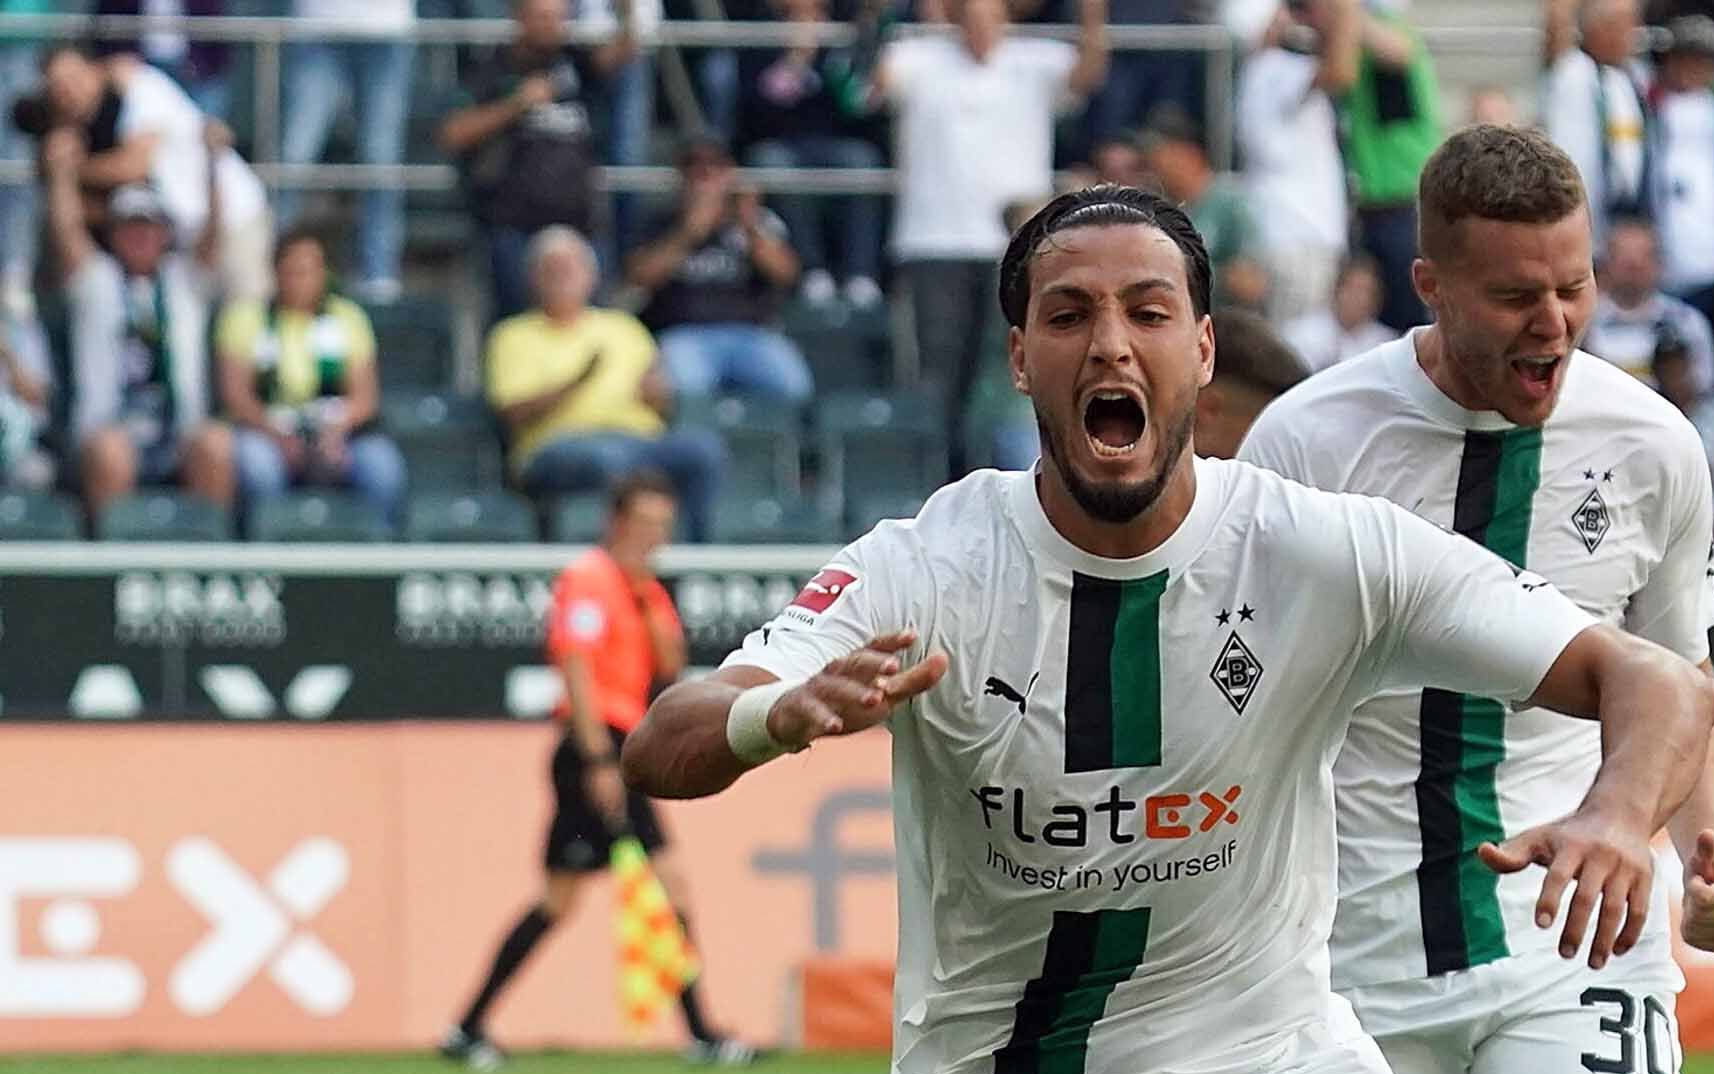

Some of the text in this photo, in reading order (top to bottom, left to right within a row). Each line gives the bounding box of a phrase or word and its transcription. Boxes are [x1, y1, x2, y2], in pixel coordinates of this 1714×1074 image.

[986, 840, 1236, 891] Invest in yourself
